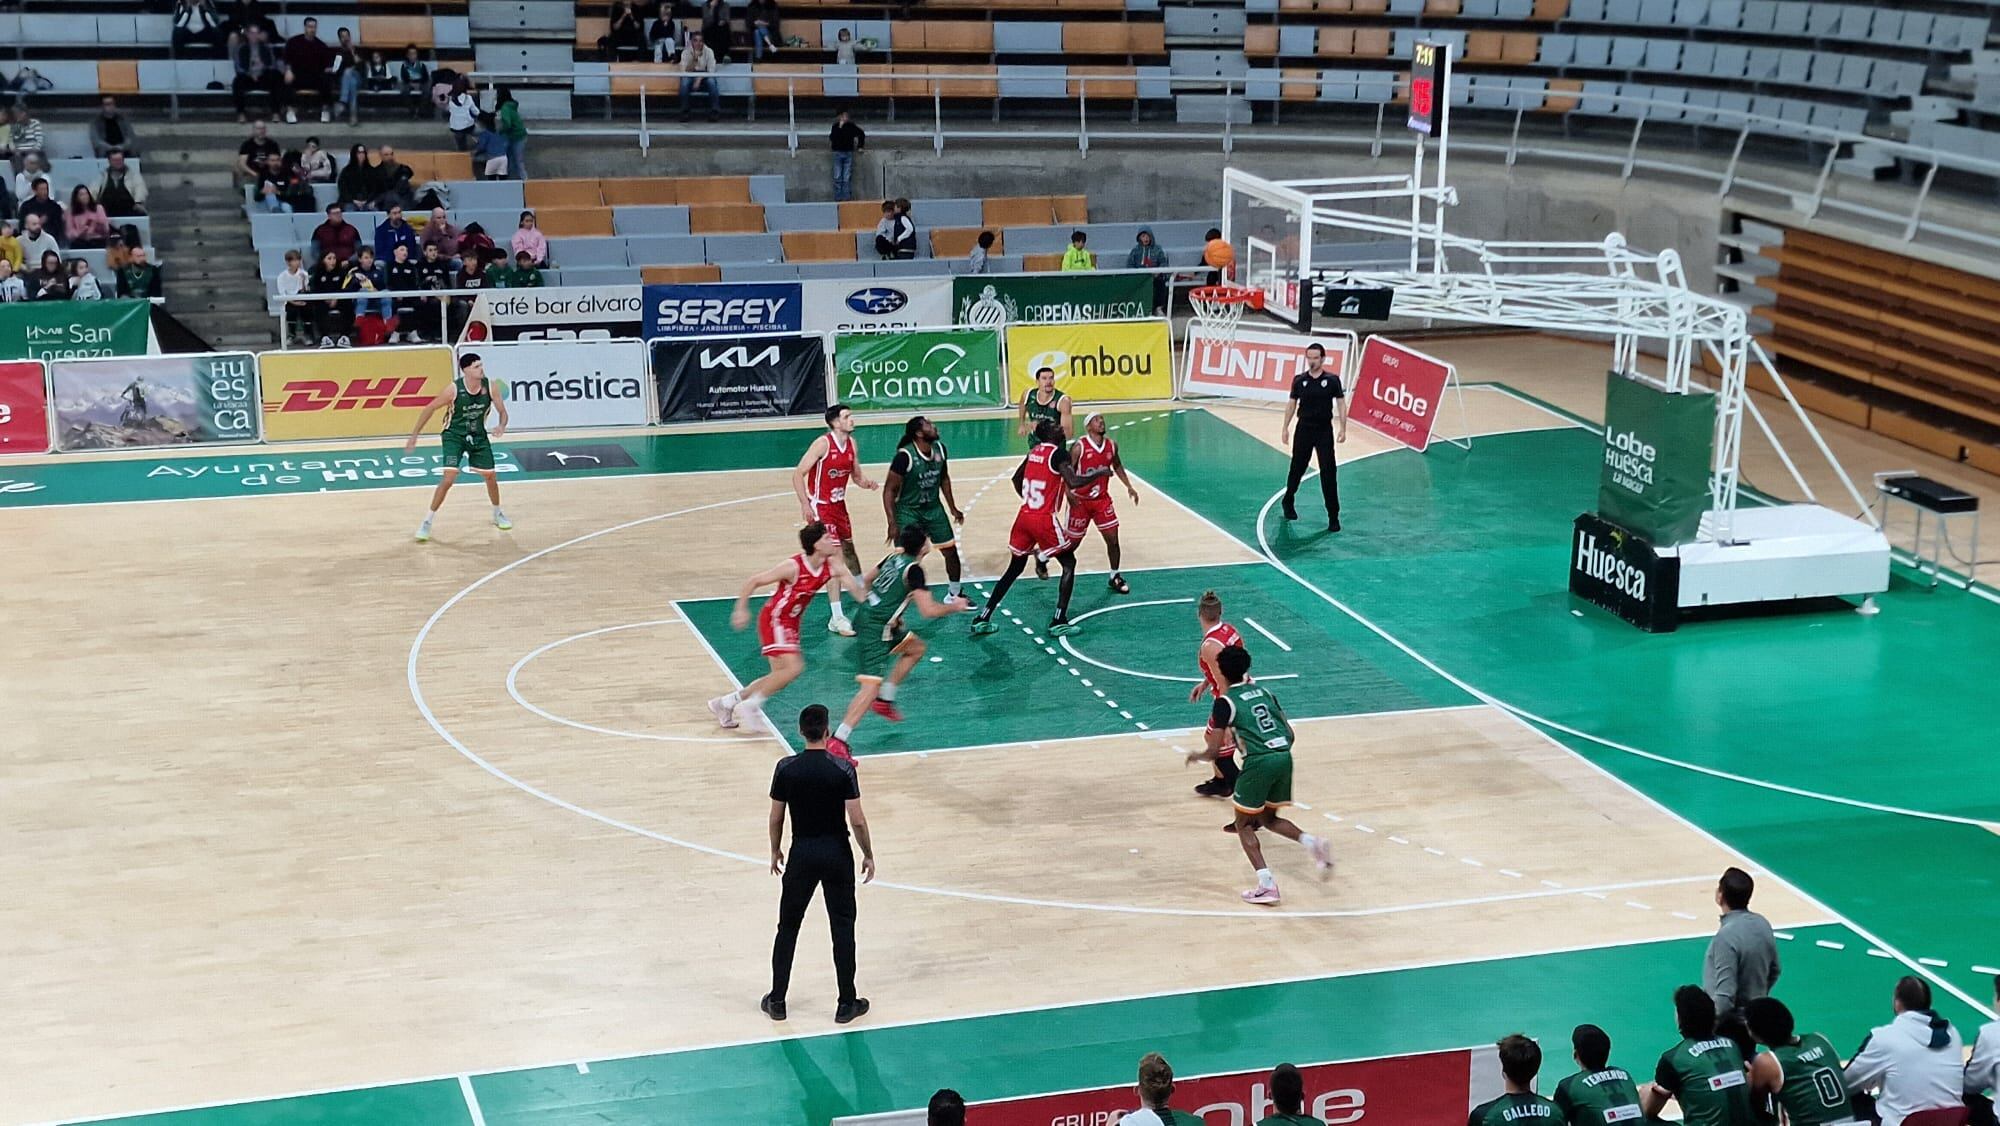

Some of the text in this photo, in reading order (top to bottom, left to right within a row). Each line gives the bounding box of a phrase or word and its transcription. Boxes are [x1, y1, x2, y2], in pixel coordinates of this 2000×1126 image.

[489, 295, 642, 316] café bar álvaro
[657, 298, 786, 325] SERFEY
[69, 323, 112, 343] San
[657, 324, 695, 332] LIMPIEZA
[850, 359, 909, 375] Grupo
[281, 376, 437, 413] DHL
[708, 384, 777, 394] Automotor Huesca
[849, 370, 991, 398] Aramóvil
[1373, 377, 1428, 416] Lobe
[1606, 426, 1656, 462] Lobe
[1605, 448, 1653, 484] Huesca
[241, 474, 302, 487] de
[1576, 530, 1646, 602] Huesca
[1252, 703, 1277, 733] 2
[1812, 1067, 1845, 1108] 0
[1051, 1110, 1110, 1126] GRUP
[1503, 1106, 1551, 1122] GALLEGO
